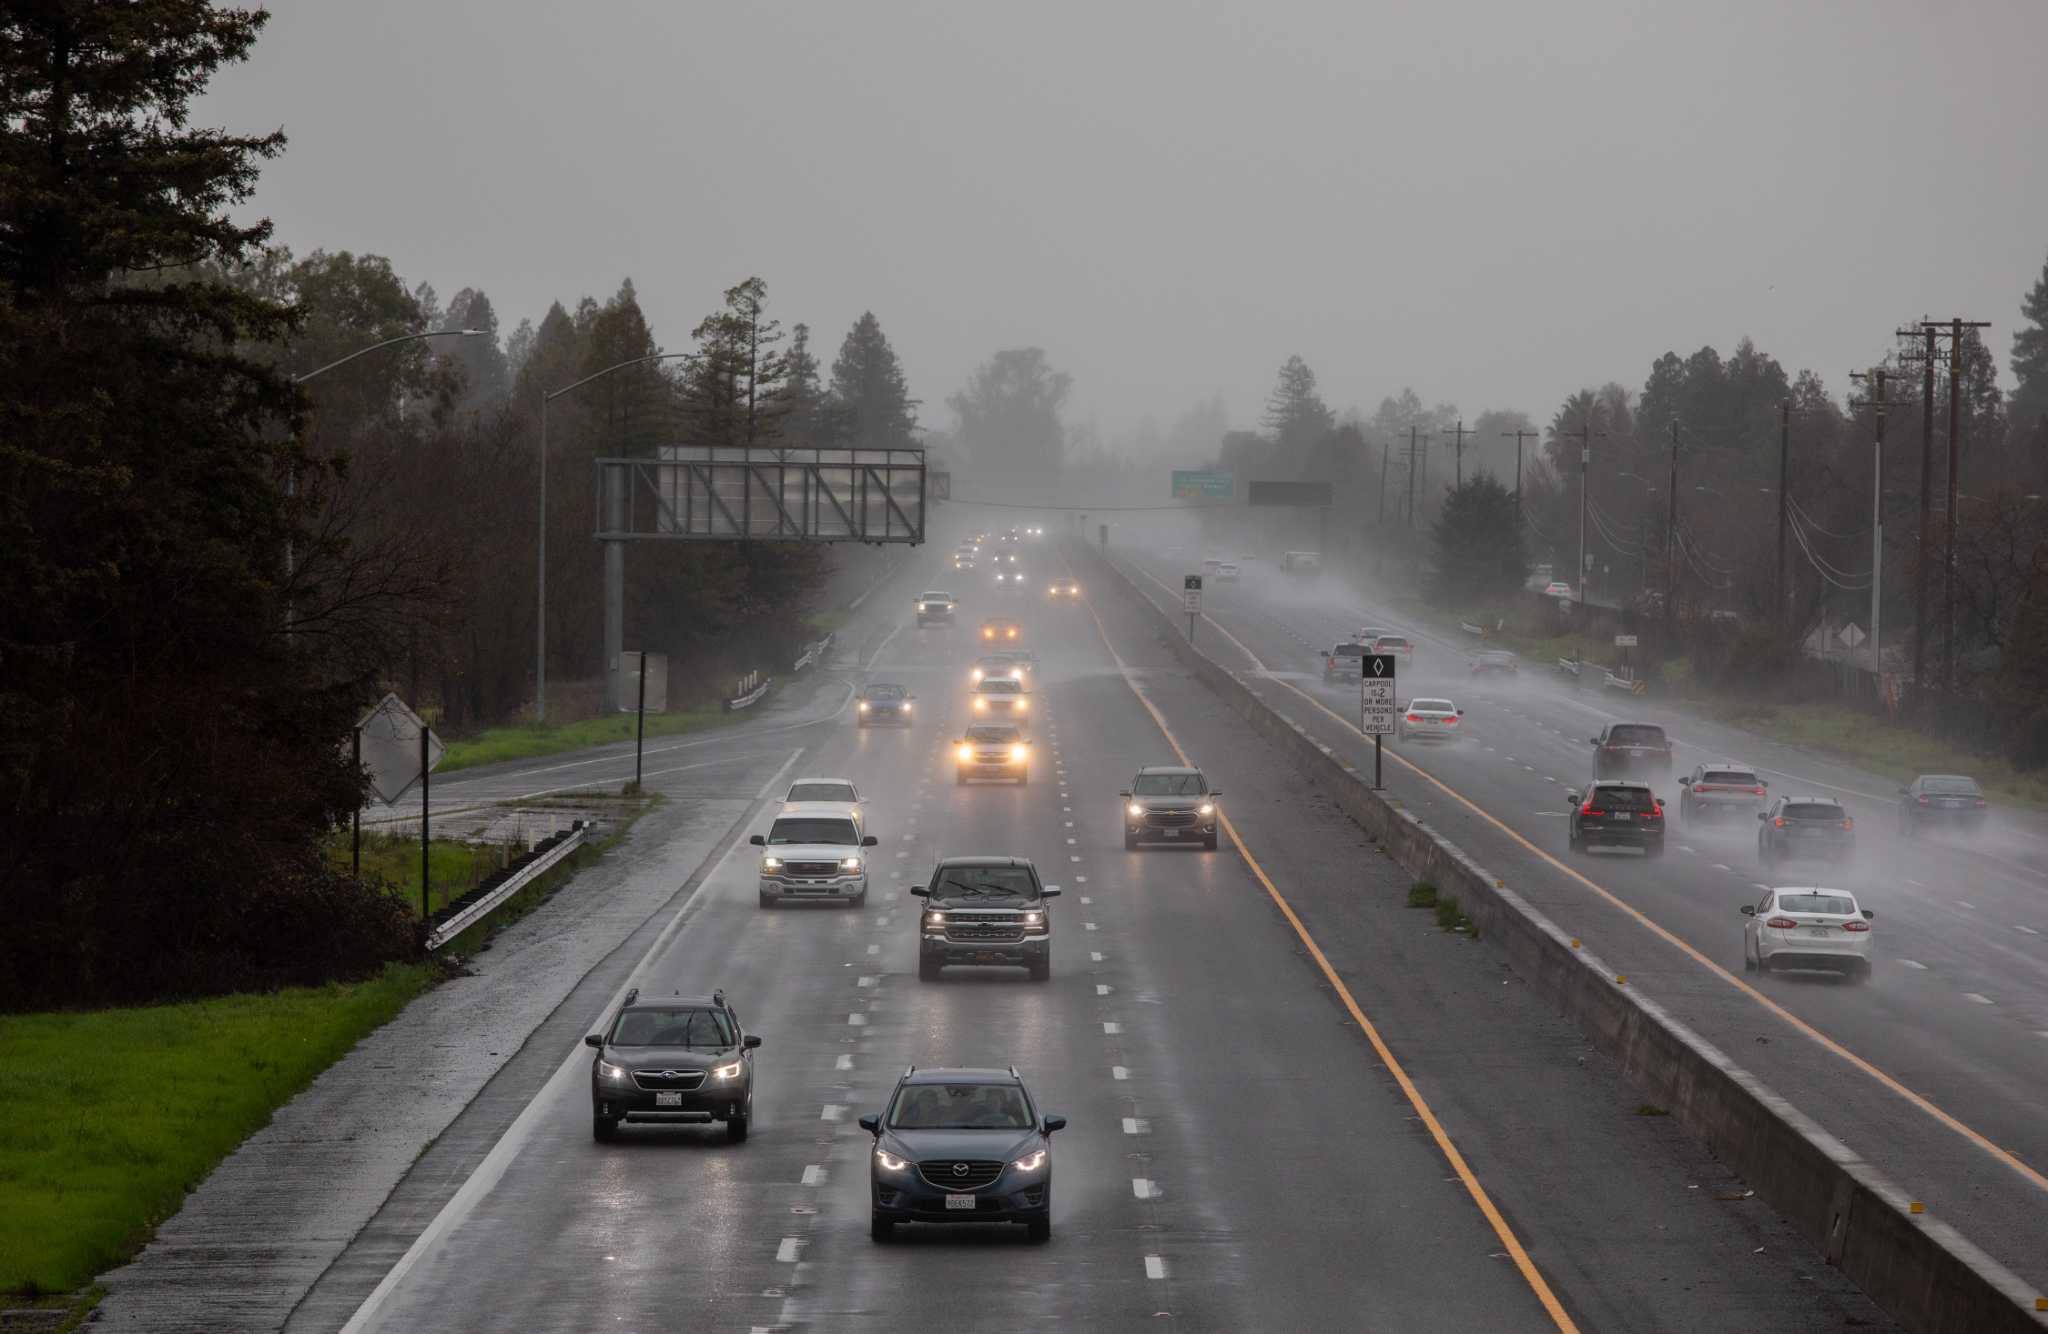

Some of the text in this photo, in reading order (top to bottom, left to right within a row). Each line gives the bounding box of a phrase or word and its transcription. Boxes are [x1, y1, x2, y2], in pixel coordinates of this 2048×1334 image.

[1364, 680, 1392, 688] CARPOOL
[1379, 687, 1386, 698] 2
[1364, 698, 1392, 706] OR MORE
[1365, 724, 1391, 732] VEHICLE
